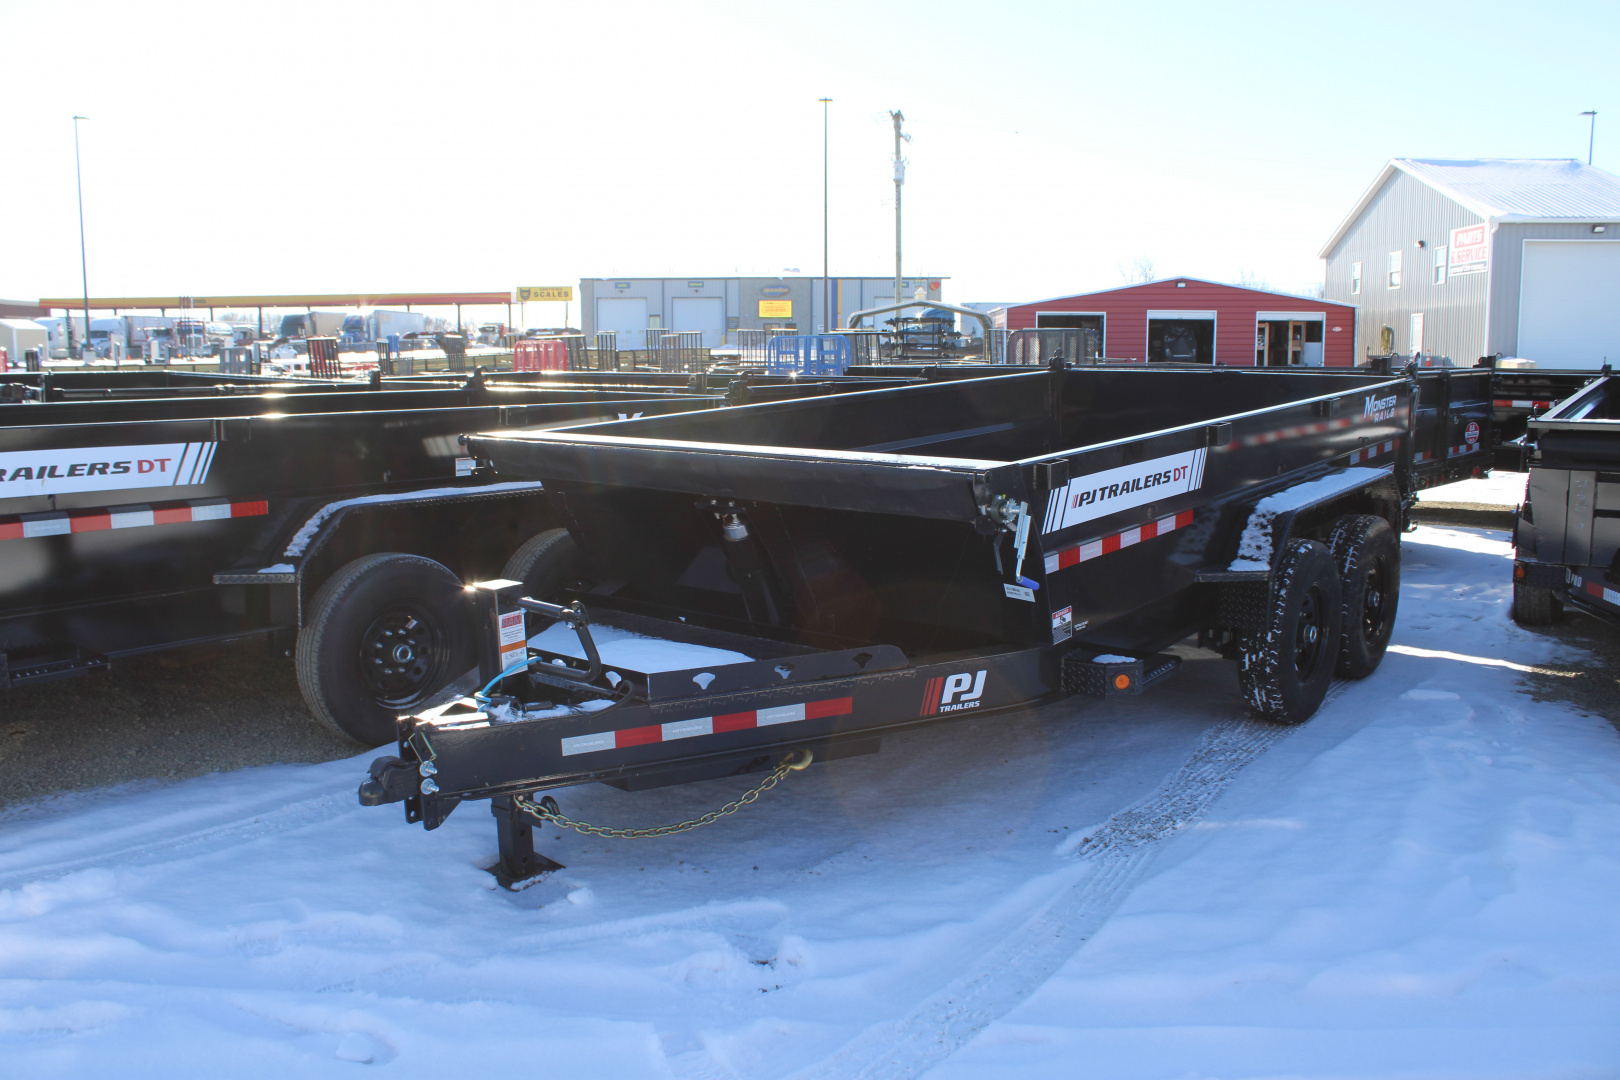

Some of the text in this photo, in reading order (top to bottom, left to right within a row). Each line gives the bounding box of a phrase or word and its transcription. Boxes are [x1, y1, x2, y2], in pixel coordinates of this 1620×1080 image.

[1456, 230, 1483, 247] PARTS
[1450, 246, 1487, 264] & SERVICE
[1363, 394, 1397, 419] MONSTER
[1374, 408, 1395, 423] RAILS
[137, 458, 171, 474] DT
[1078, 465, 1188, 507] PJ TRAILERS DT
[502, 614, 523, 628] RAM
[941, 669, 987, 704] PJ
[940, 701, 981, 713] TRAILERS
